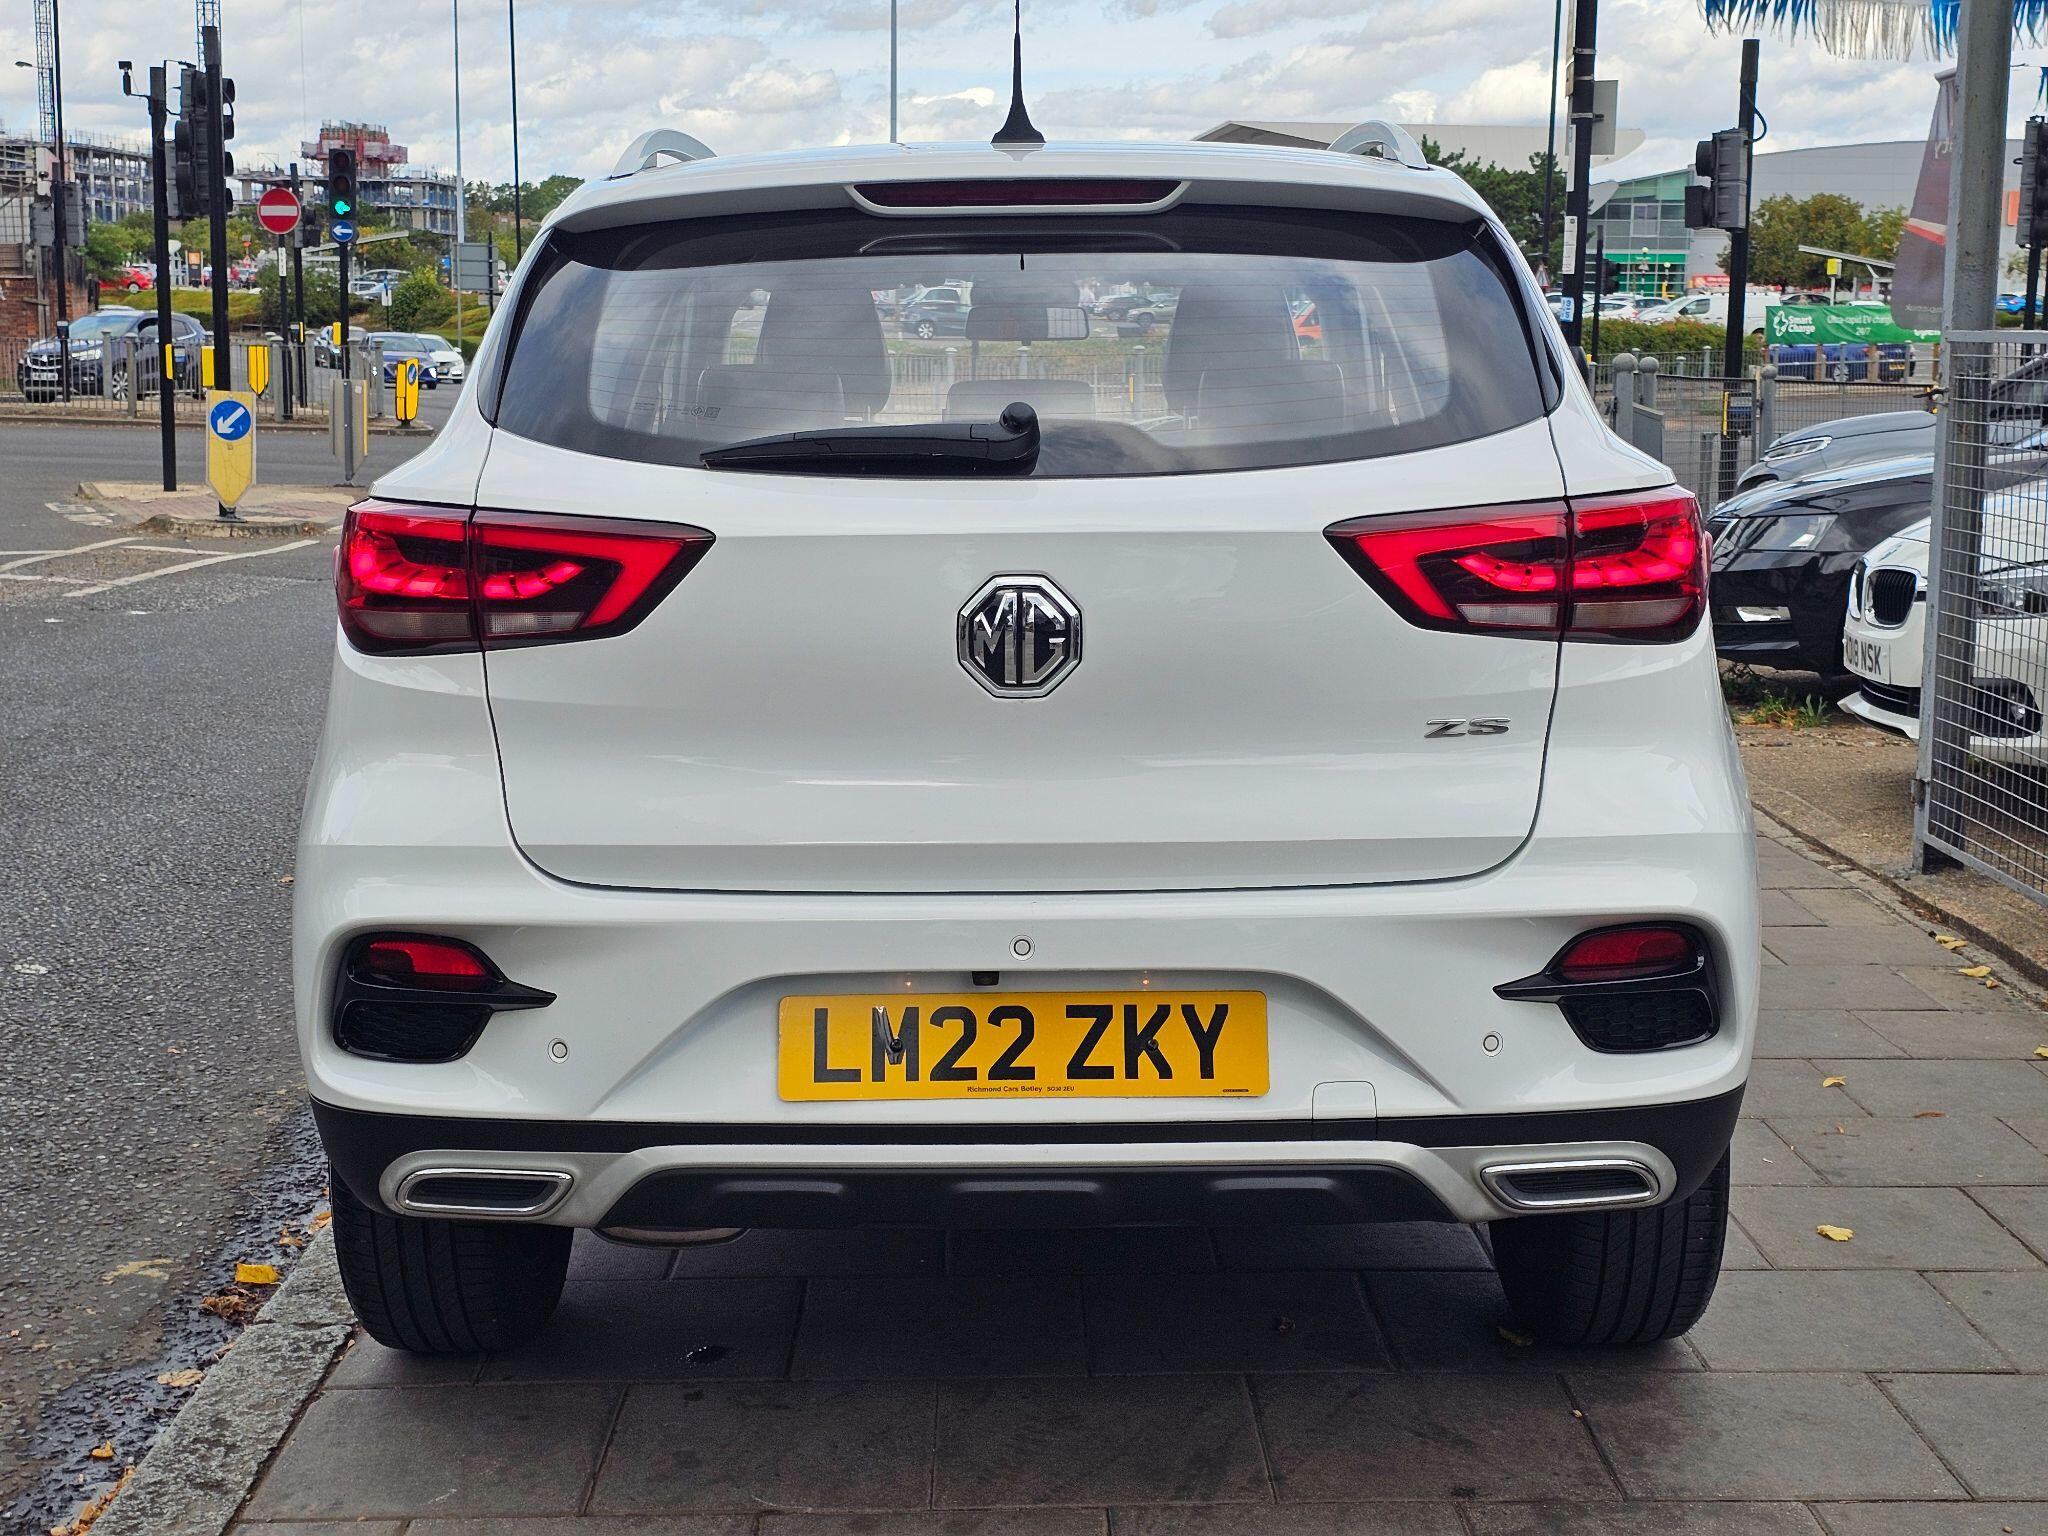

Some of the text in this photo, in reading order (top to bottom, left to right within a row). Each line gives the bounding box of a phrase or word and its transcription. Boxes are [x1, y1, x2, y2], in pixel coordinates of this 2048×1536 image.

[1788, 315, 1813, 324] Smart
[1788, 325, 1816, 335] Charge
[973, 591, 1066, 684] MG
[1860, 641, 1882, 676] NSK
[1424, 717, 1511, 738] ZS
[813, 1003, 1230, 1083] LM22 ZKY
[1020, 1085, 1043, 1093] Botley
